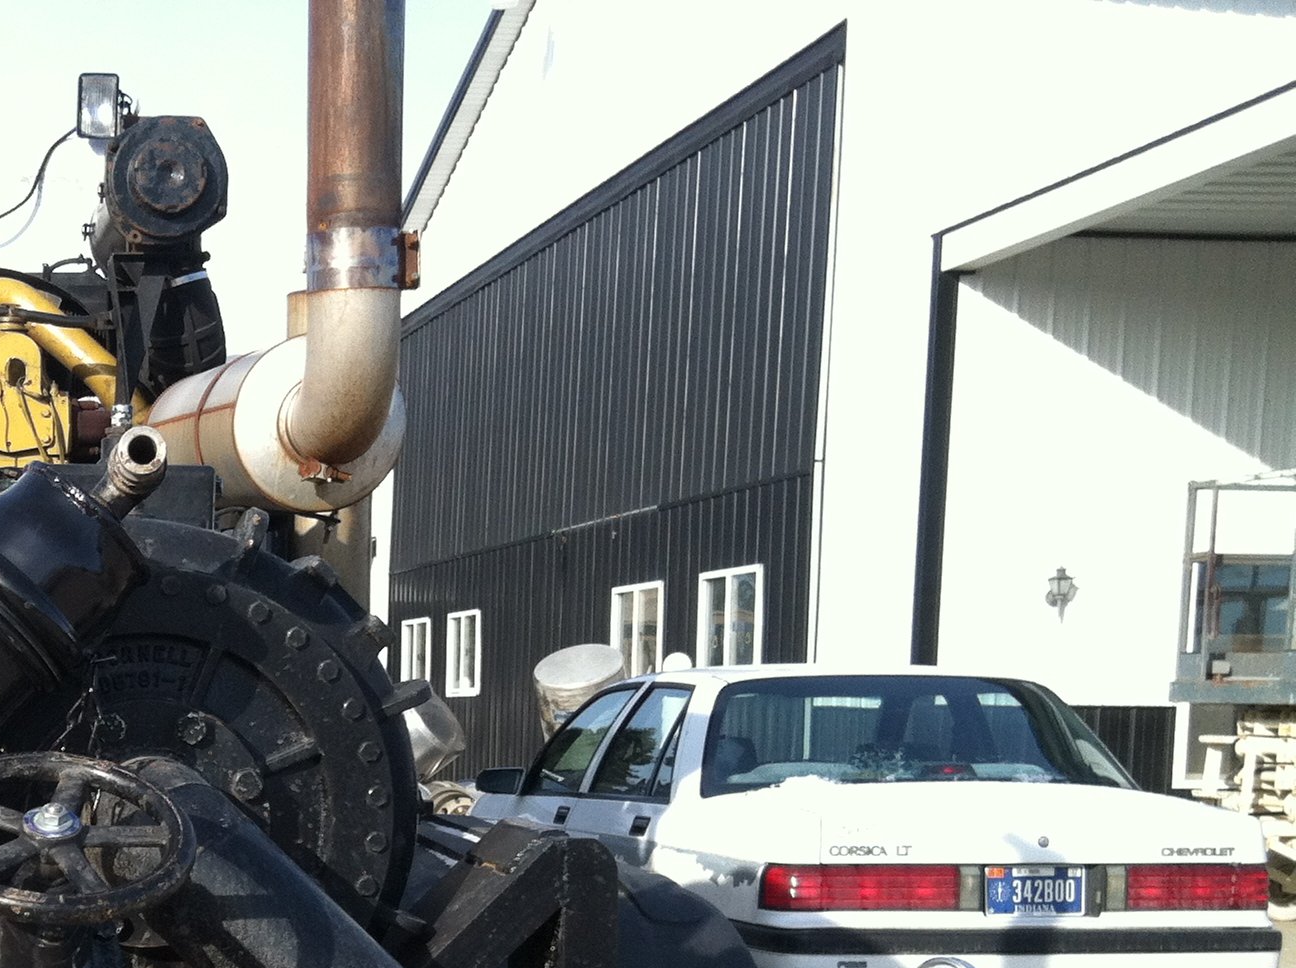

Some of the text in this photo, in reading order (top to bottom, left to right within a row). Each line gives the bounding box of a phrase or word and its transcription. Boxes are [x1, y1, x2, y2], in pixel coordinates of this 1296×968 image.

[829, 845, 912, 857] CORSICA LT
[1161, 847, 1235, 857] CHEVROLET
[1012, 879, 1075, 903] 342B00
[1014, 904, 1056, 913] INDIANA
